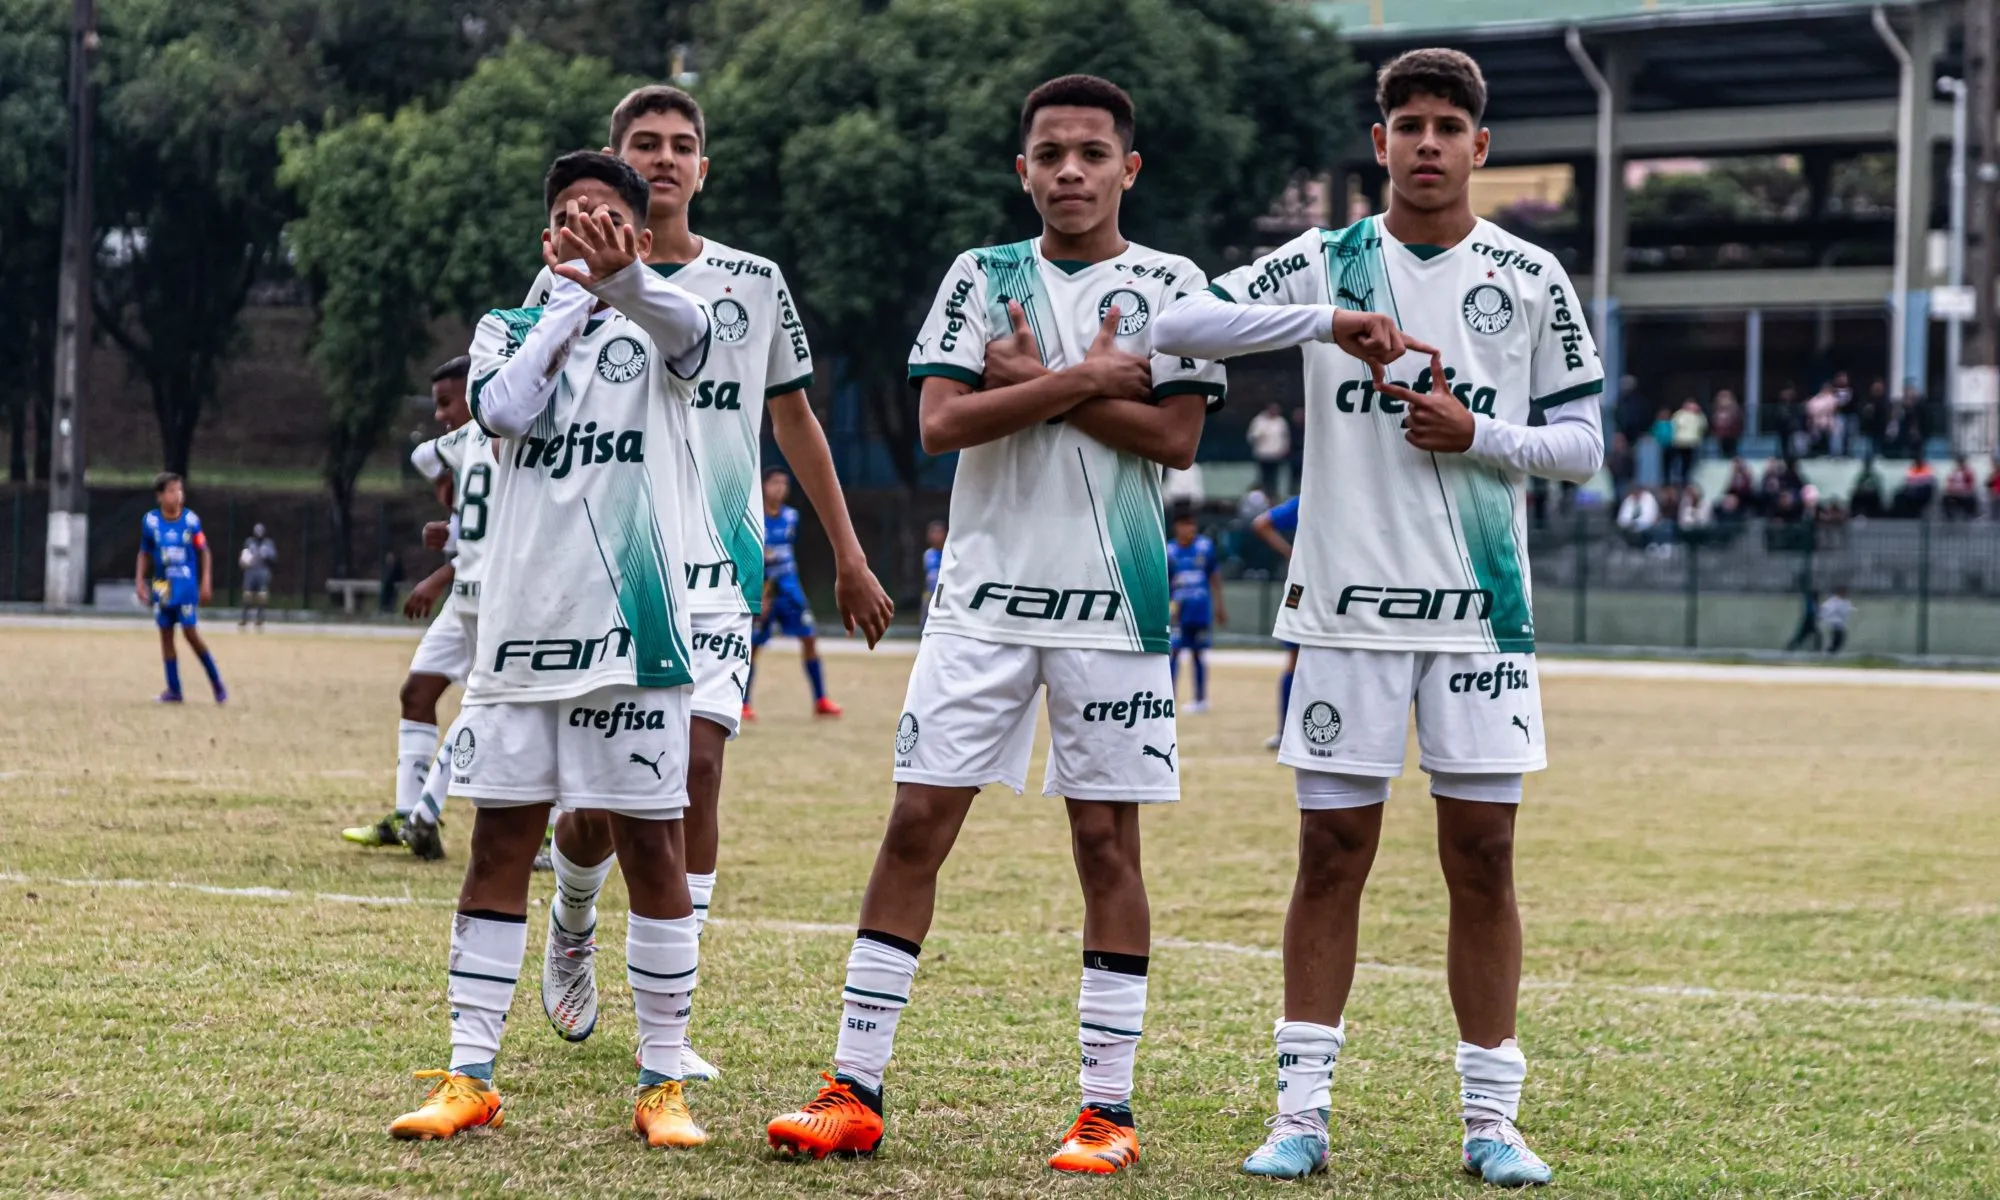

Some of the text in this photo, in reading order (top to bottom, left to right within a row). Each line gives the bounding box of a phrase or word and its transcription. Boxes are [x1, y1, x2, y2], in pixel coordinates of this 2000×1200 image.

[706, 257, 773, 278] crefisa
[1248, 253, 1310, 300] cefisa
[1472, 242, 1543, 277] crefisa
[777, 288, 809, 362] crefisa
[940, 279, 974, 353] crefisa
[1465, 304, 1511, 333] PALMEIRAS
[1549, 284, 1584, 371] crefisa
[599, 353, 645, 383] PALMEIRAS
[458, 463, 491, 540] 8
[692, 633, 750, 666] crefis
[1450, 662, 1528, 699] crefisa
[569, 702, 665, 739] crefisa
[1083, 691, 1175, 728] crefisa
[847, 1017, 877, 1032] SEP
